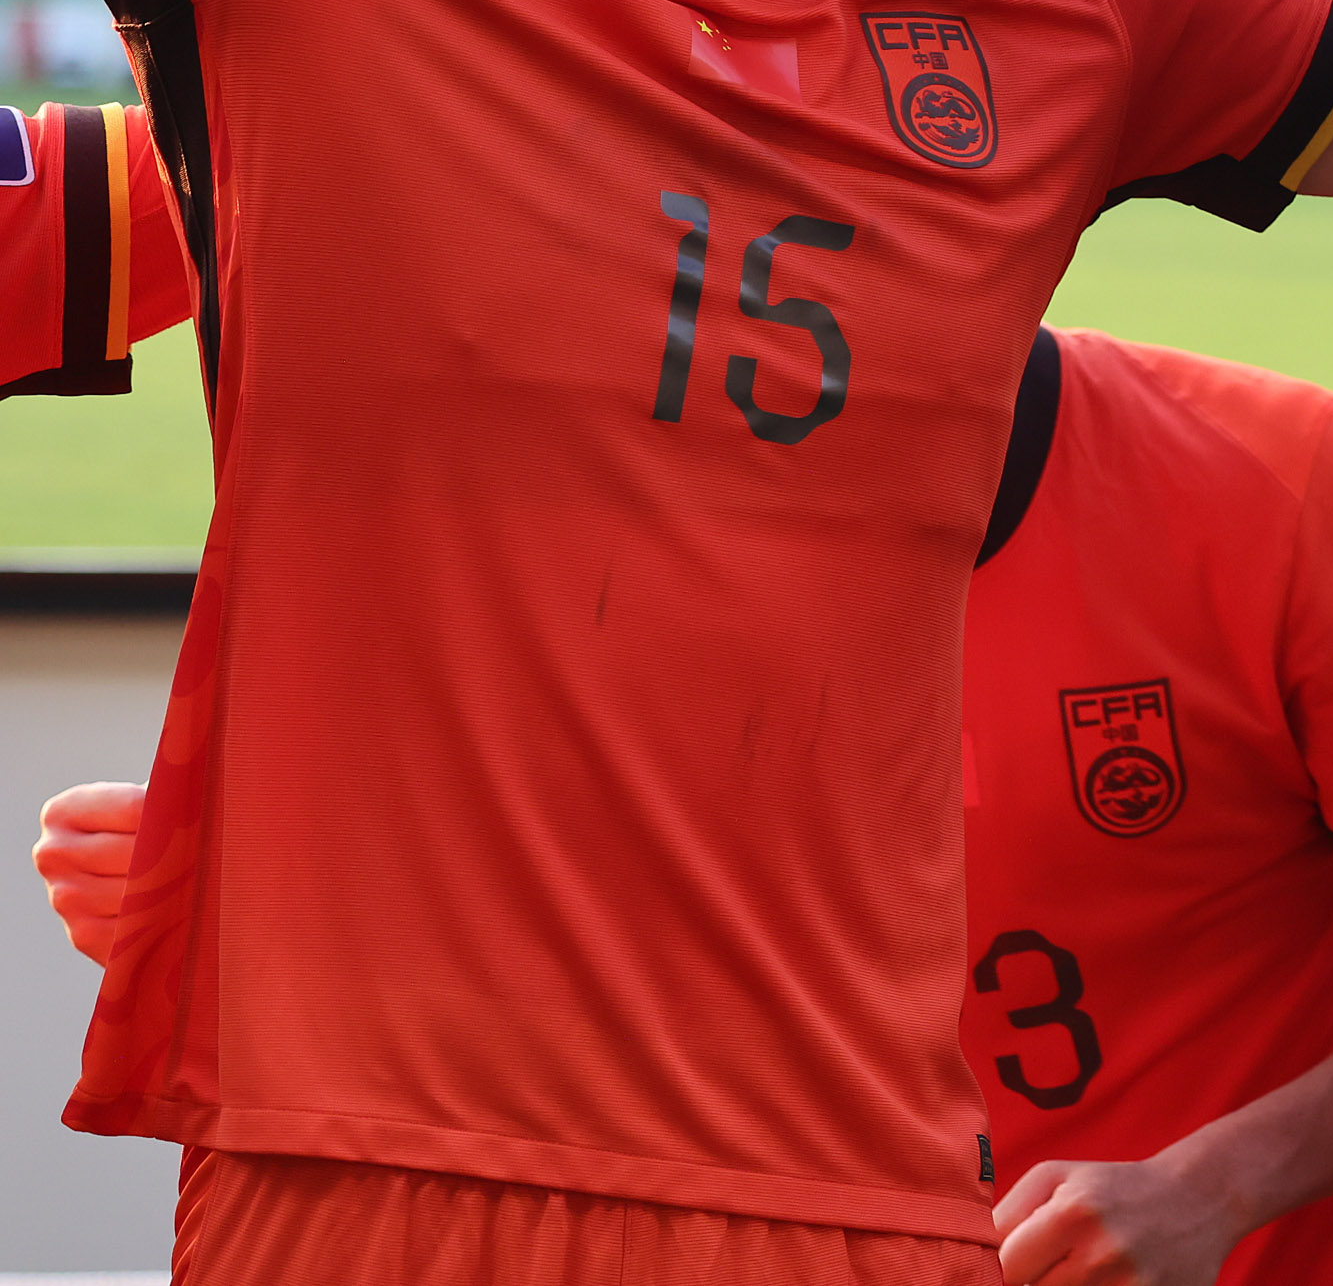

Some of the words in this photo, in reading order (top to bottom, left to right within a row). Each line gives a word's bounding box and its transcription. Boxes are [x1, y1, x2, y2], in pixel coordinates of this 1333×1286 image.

[874, 21, 970, 51] CFA
[911, 50, 950, 70] 中国
[651, 190, 856, 446] 15
[1072, 692, 1163, 728] CFA
[973, 928, 1103, 1110] 3
